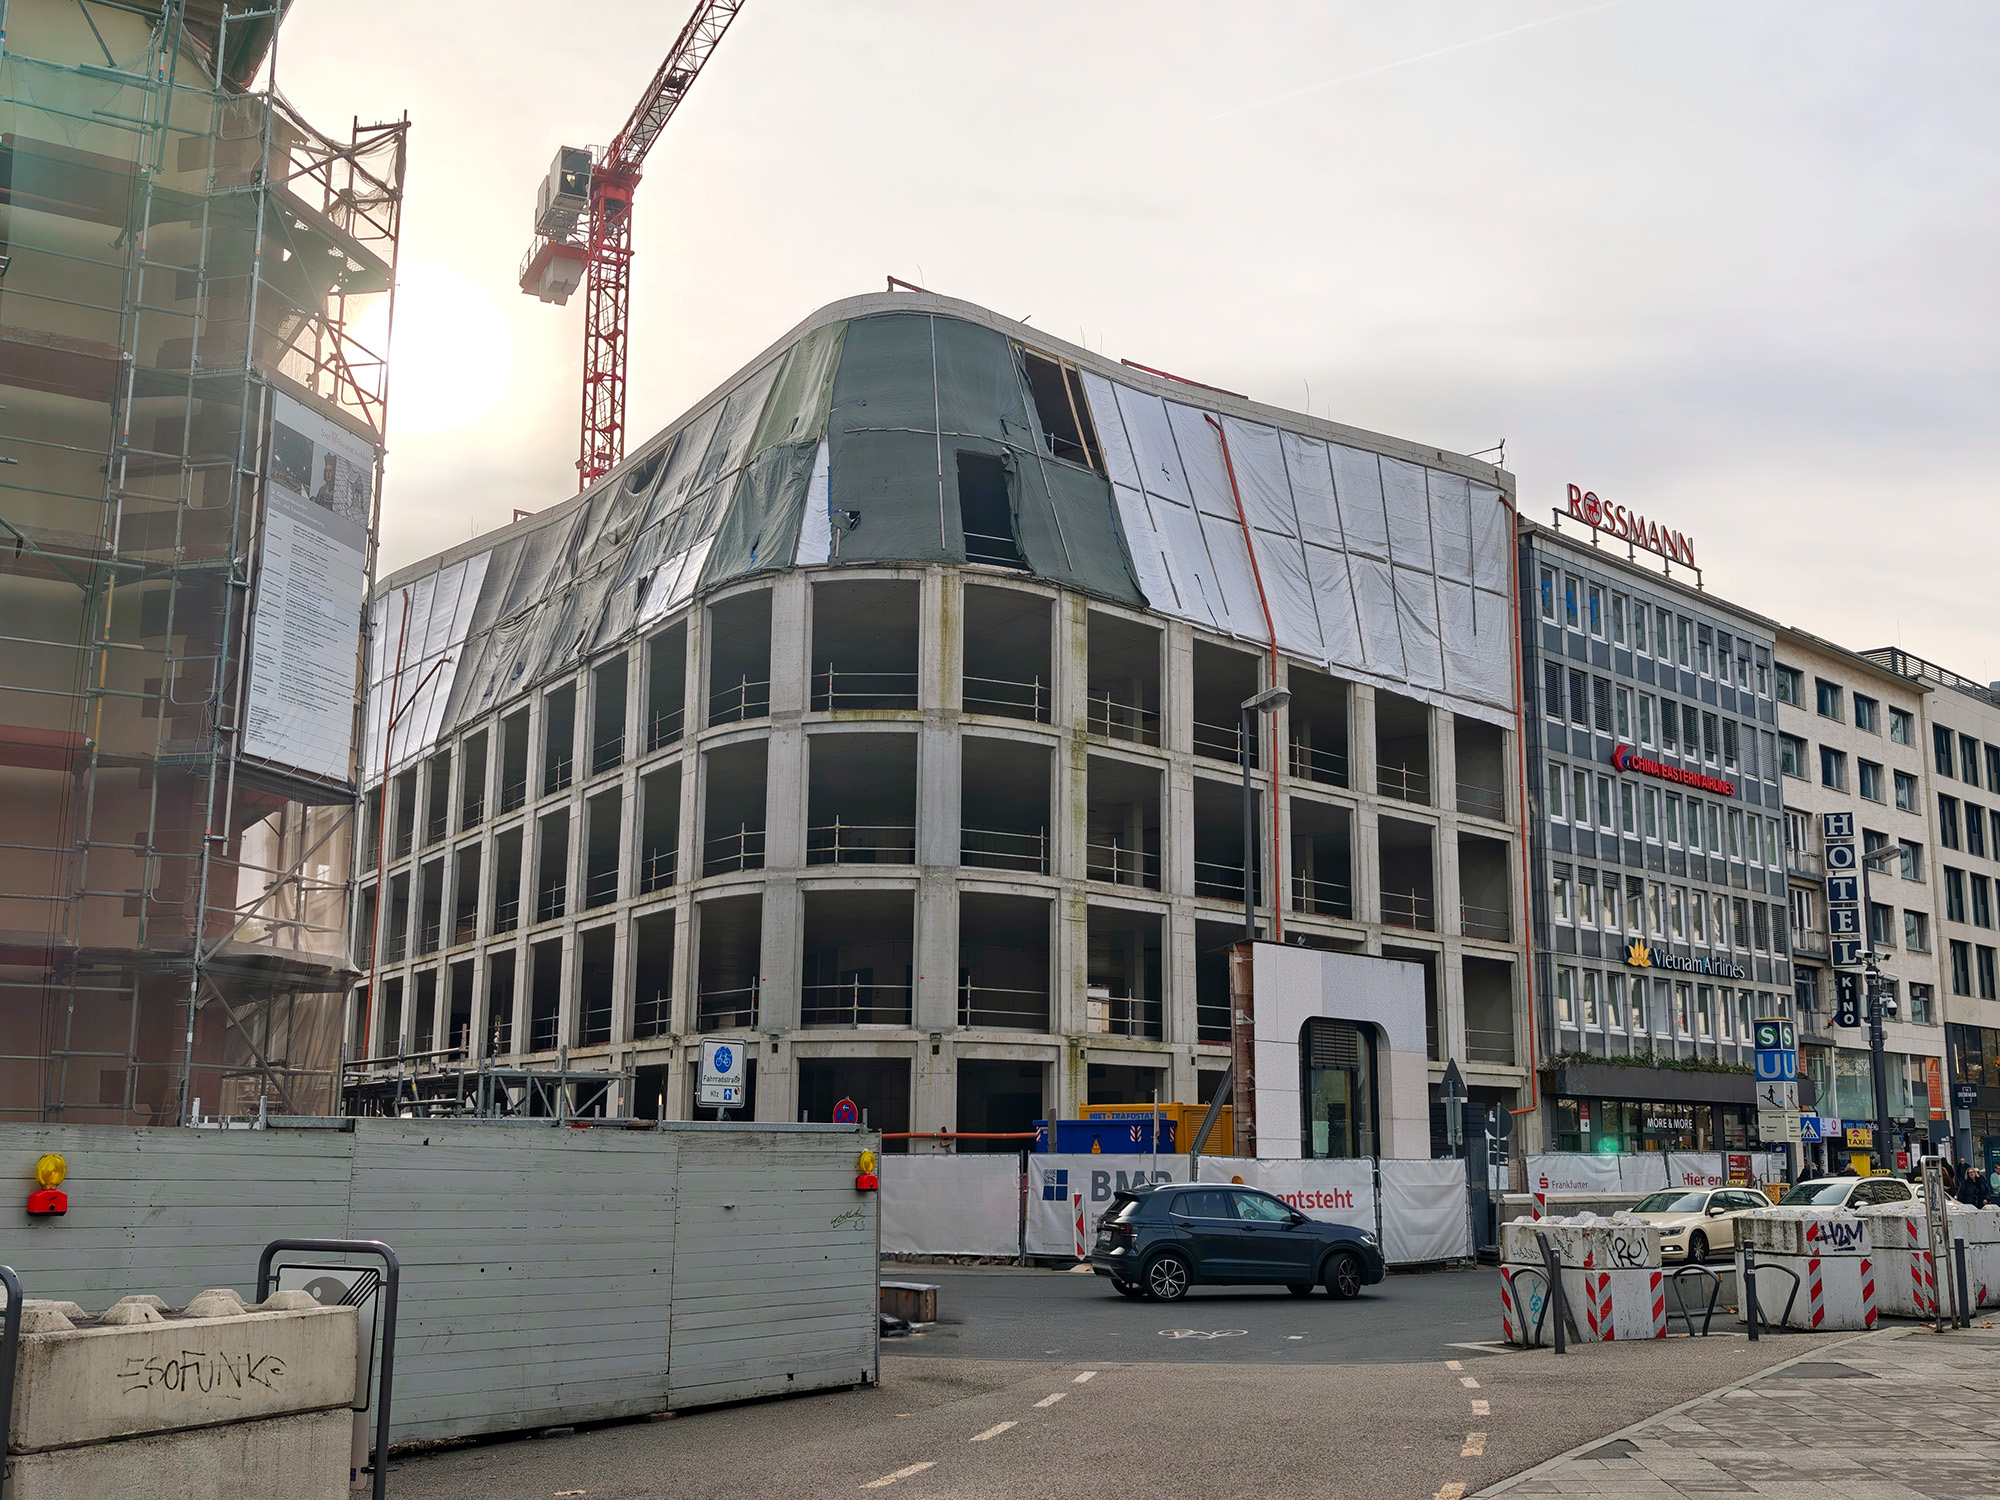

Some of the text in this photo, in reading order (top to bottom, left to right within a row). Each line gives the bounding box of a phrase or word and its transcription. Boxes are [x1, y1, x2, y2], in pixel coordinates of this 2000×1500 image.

[1567, 483, 1694, 568] ROSSMANN
[1630, 755, 1735, 796] CHINA EASTERN AIRLINES
[1826, 814, 1857, 964] HOTEL
[1654, 948, 1745, 979] Vietnam Airlines
[1841, 977, 1855, 1025] KINO
[1760, 1027, 1776, 1045] S
[1757, 1053, 1782, 1079] U
[1646, 1117, 1693, 1129] MORE & MORE
[1848, 1138, 1866, 1146] TAXI
[1551, 1180, 1588, 1189] Frankfurter
[1681, 1172, 1705, 1186] Hier
